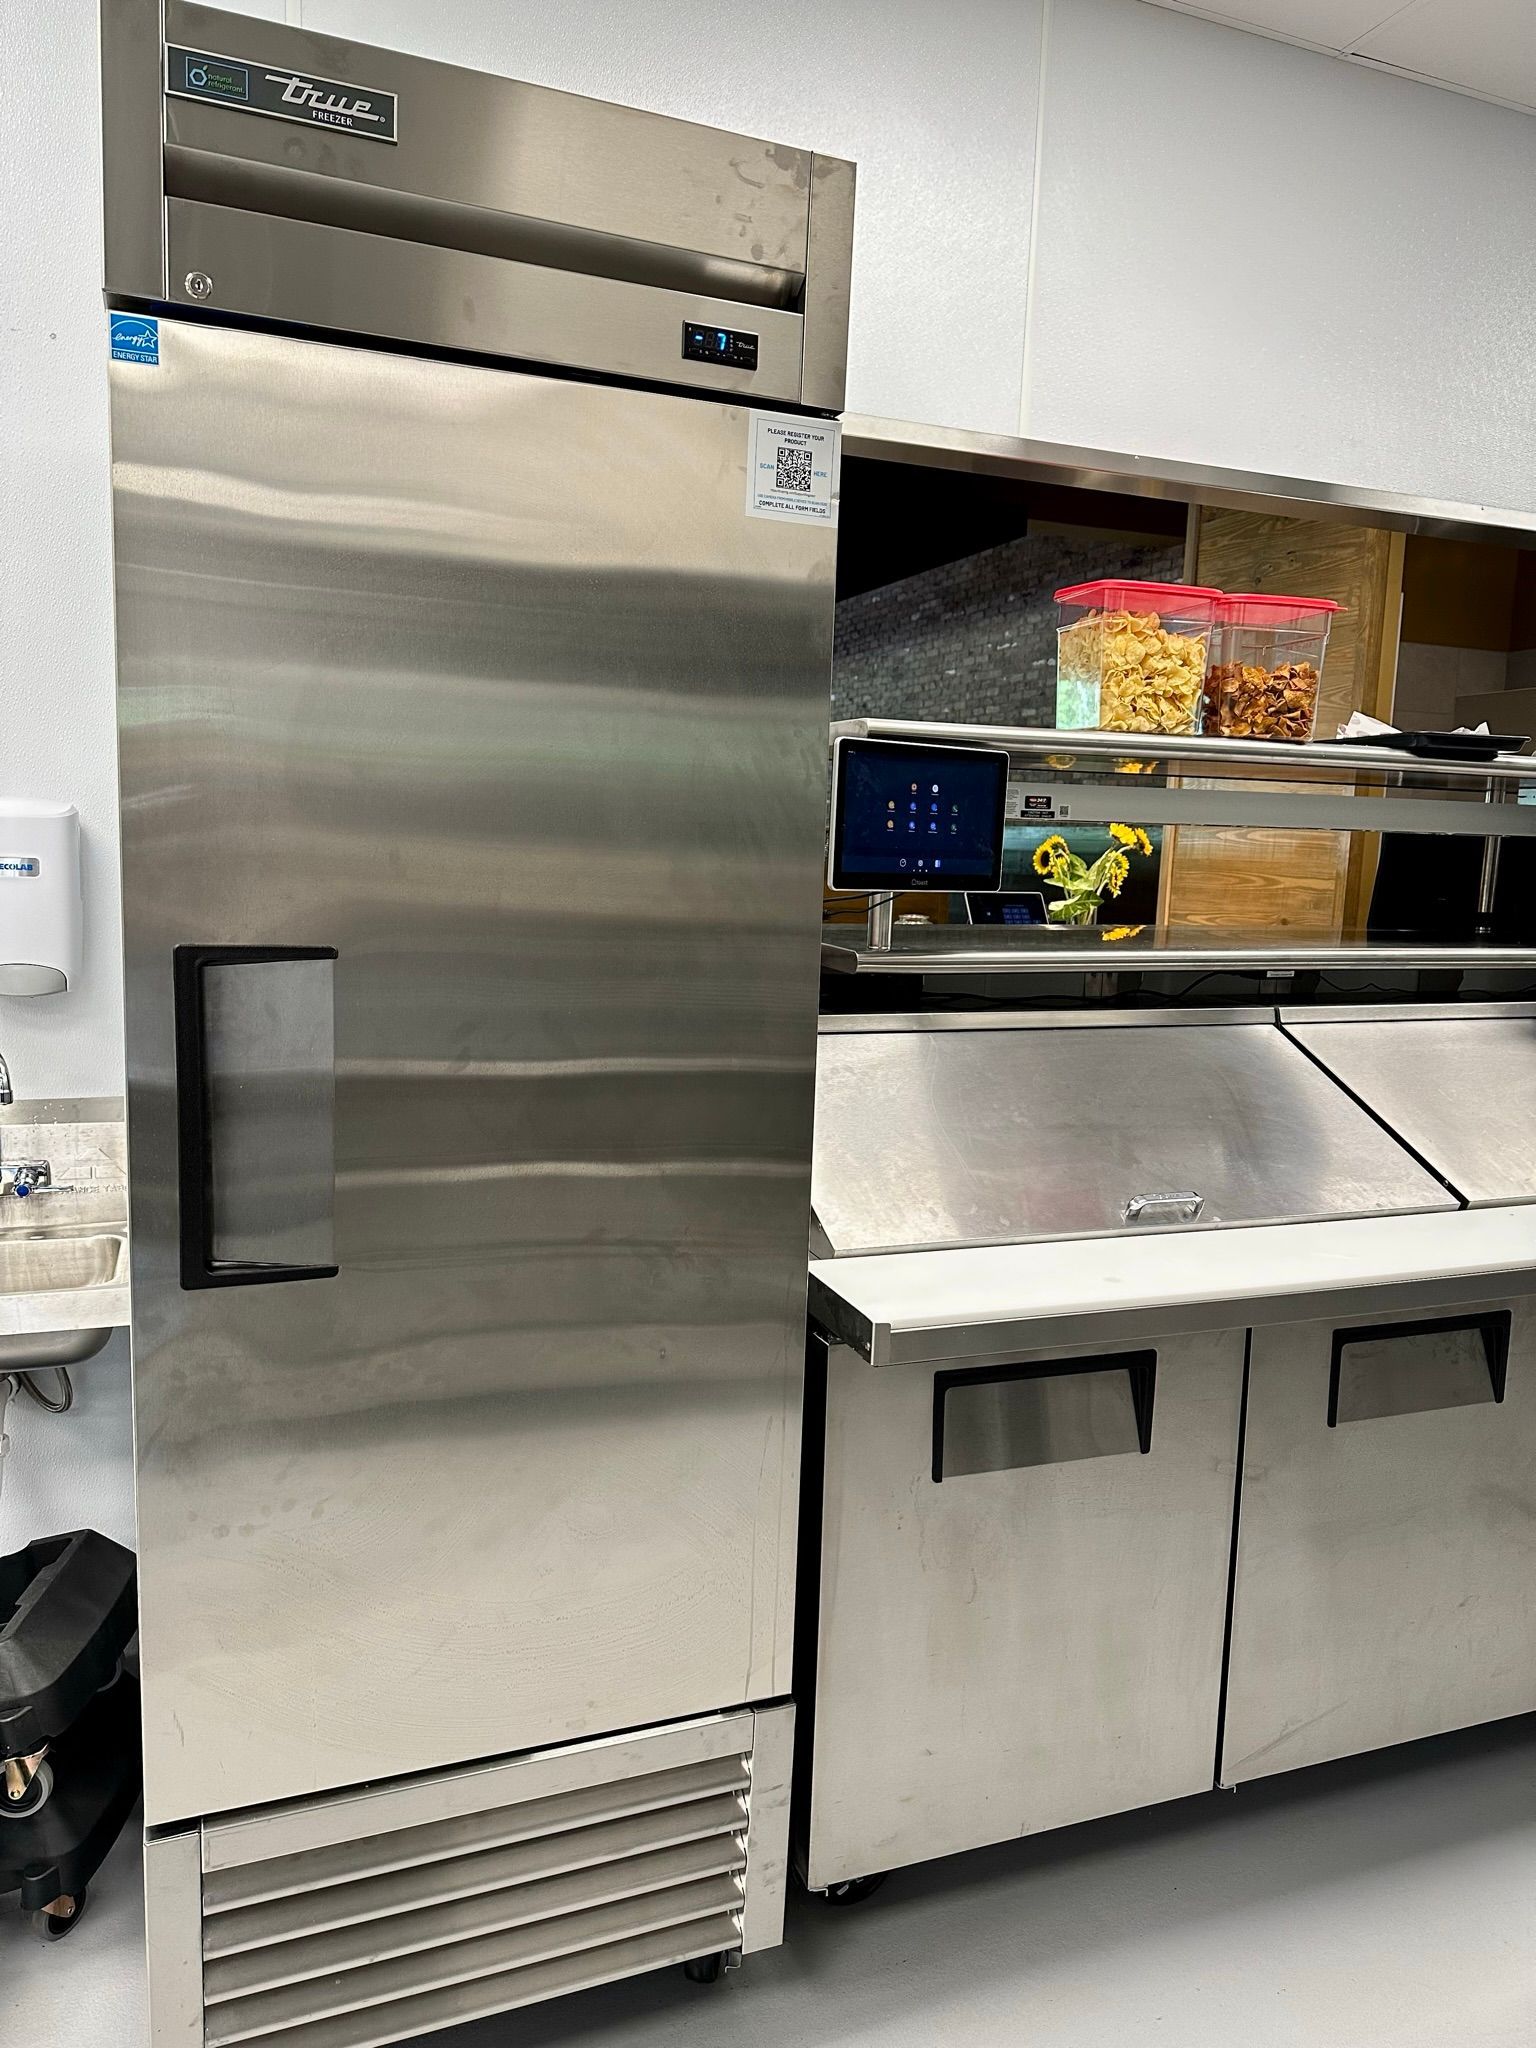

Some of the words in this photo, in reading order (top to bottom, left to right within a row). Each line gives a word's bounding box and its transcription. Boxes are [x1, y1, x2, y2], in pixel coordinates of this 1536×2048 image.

[312, 110, 353, 126] FREEZER
[113, 351, 140, 361] ENERGY
[140, 355, 158, 363] STAR
[767, 427, 786, 436] PLEASE
[787, 430, 811, 439] REGISTER
[812, 434, 825, 442] YOUR
[784, 438, 807, 446] PRODUCT
[759, 462, 775, 470] SCAN
[758, 500, 785, 509] COMPLETE
[809, 506, 826, 514] FIELDS
[0, 863, 33, 871] ECOLAB
